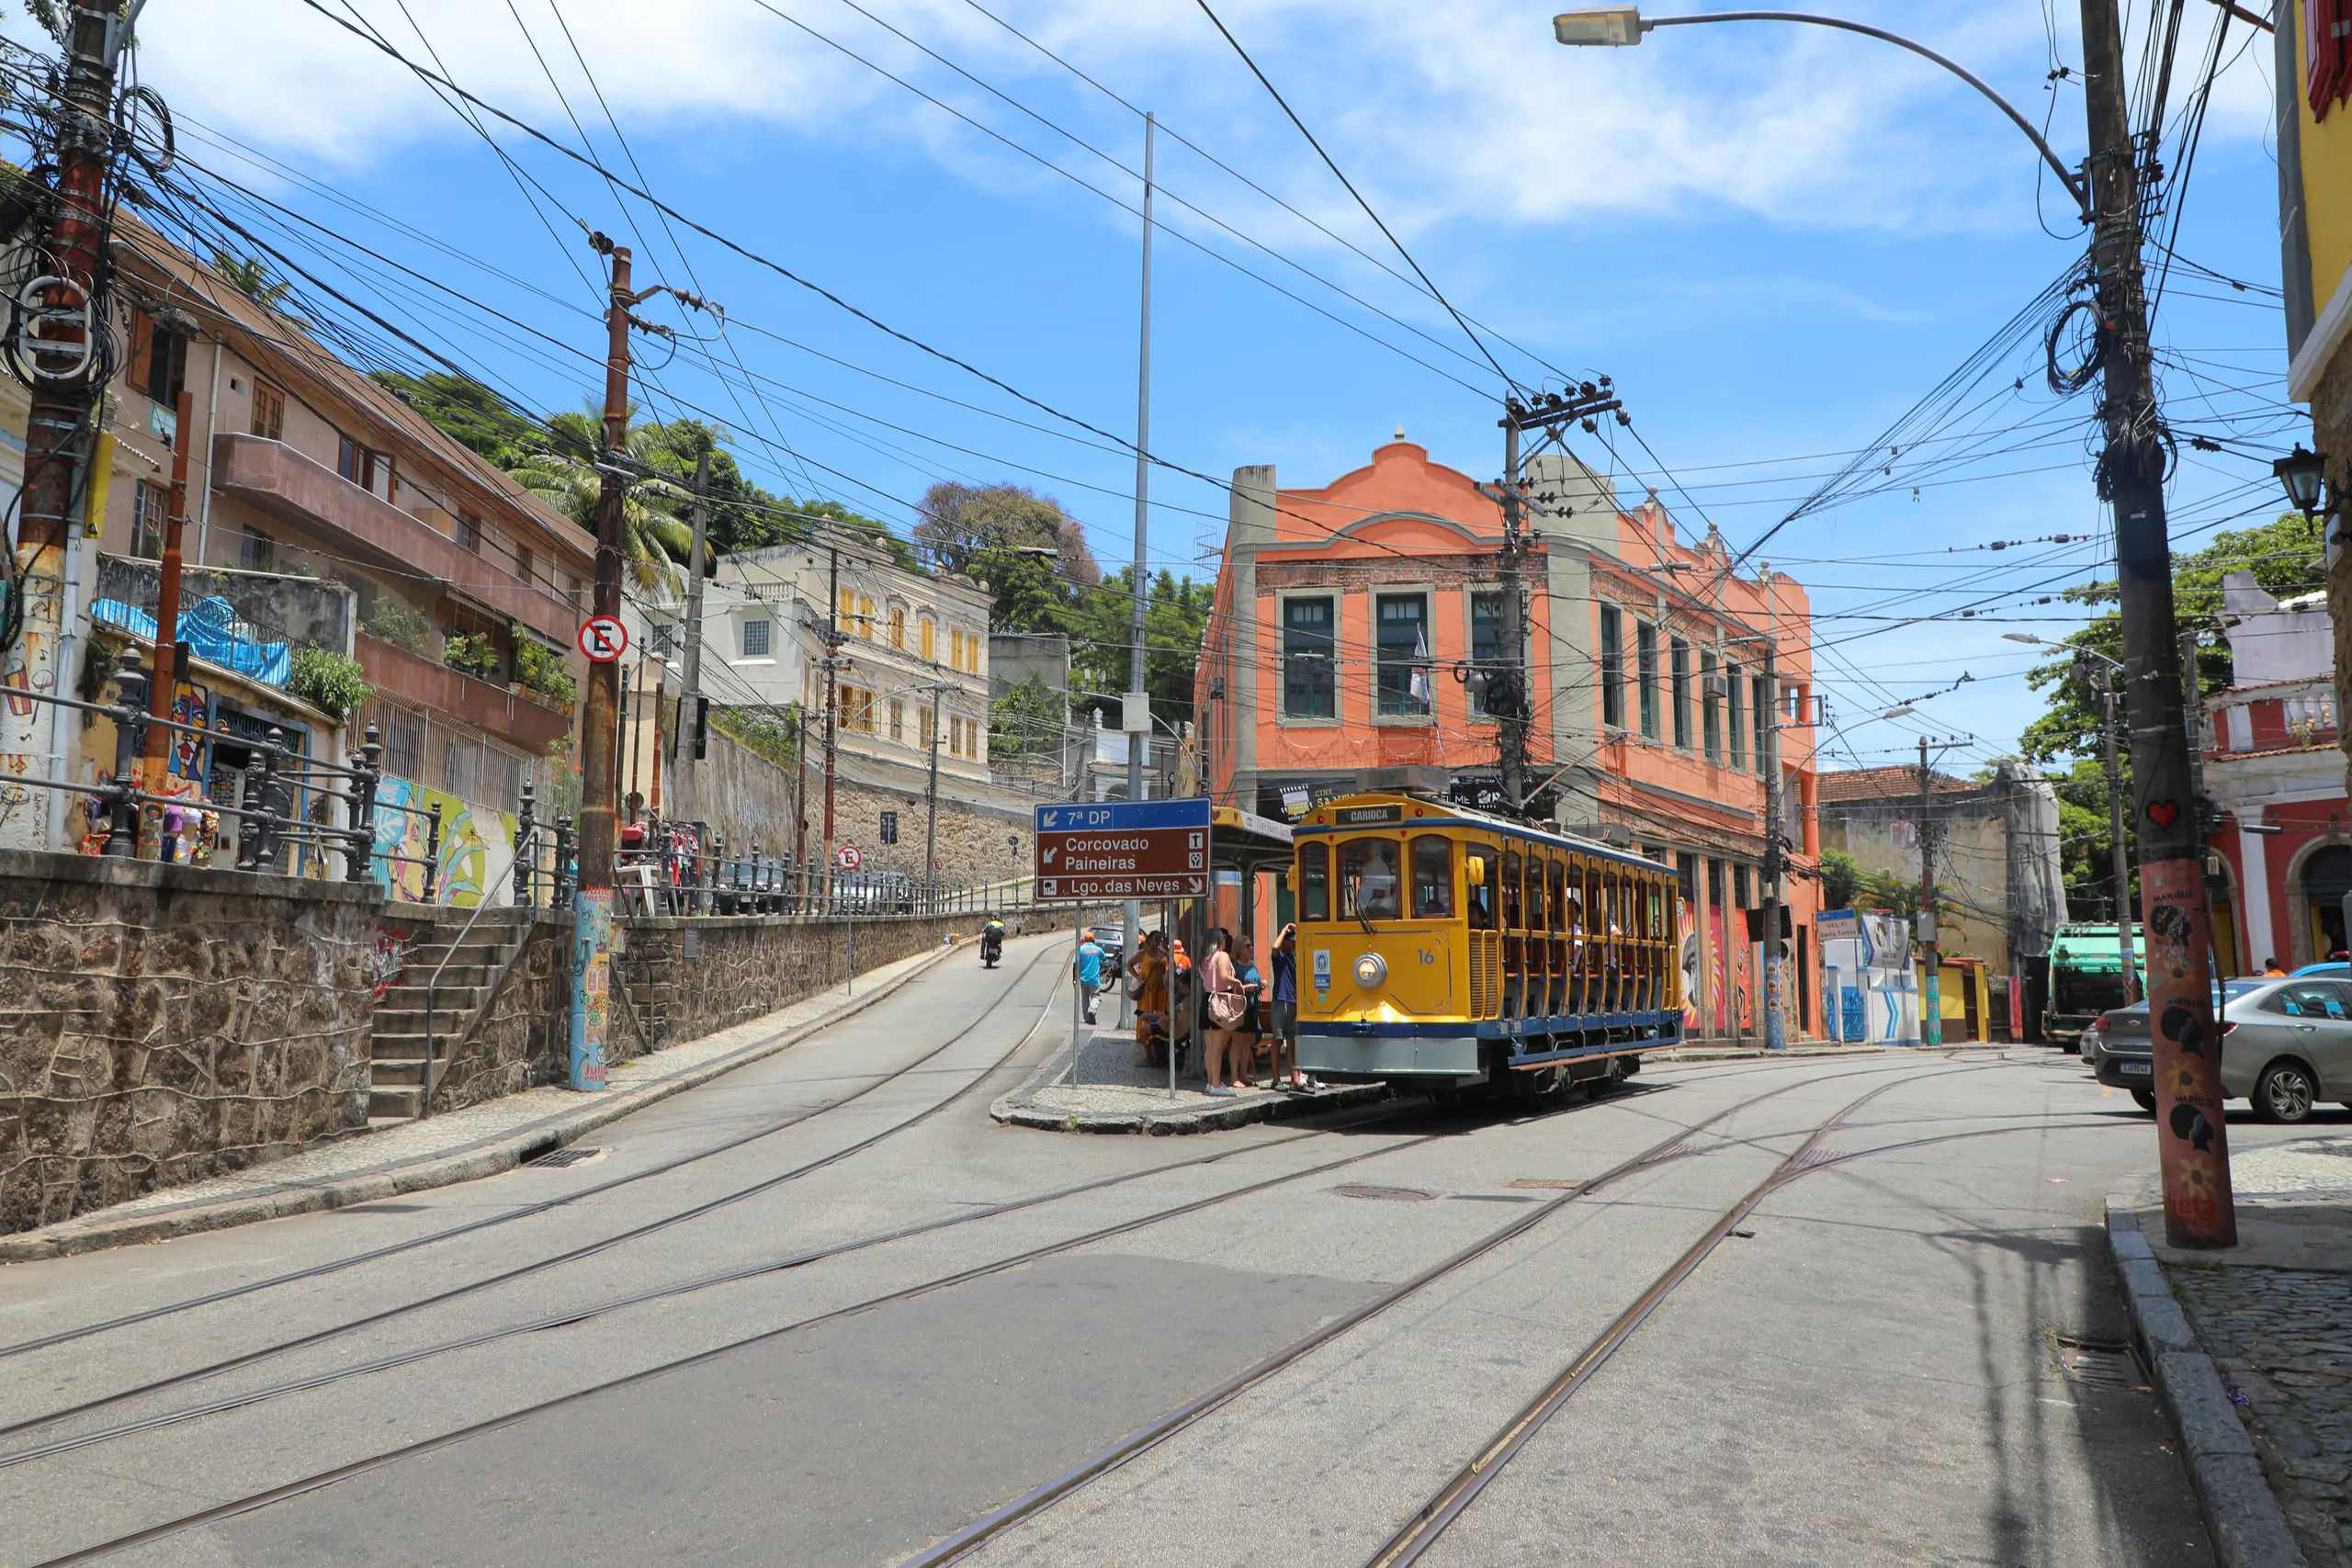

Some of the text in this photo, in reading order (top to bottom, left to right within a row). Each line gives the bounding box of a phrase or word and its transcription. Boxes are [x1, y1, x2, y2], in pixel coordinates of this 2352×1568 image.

[1315, 787, 1333, 797] CINE
[1089, 810, 1110, 825] DP
[1351, 808, 1388, 822] CARIOCA
[1066, 837, 1148, 852] Corcovado
[1066, 856, 1136, 870] Paineiras
[1071, 877, 1180, 897] Lgo. das Neves
[1417, 949, 1434, 964] 16
